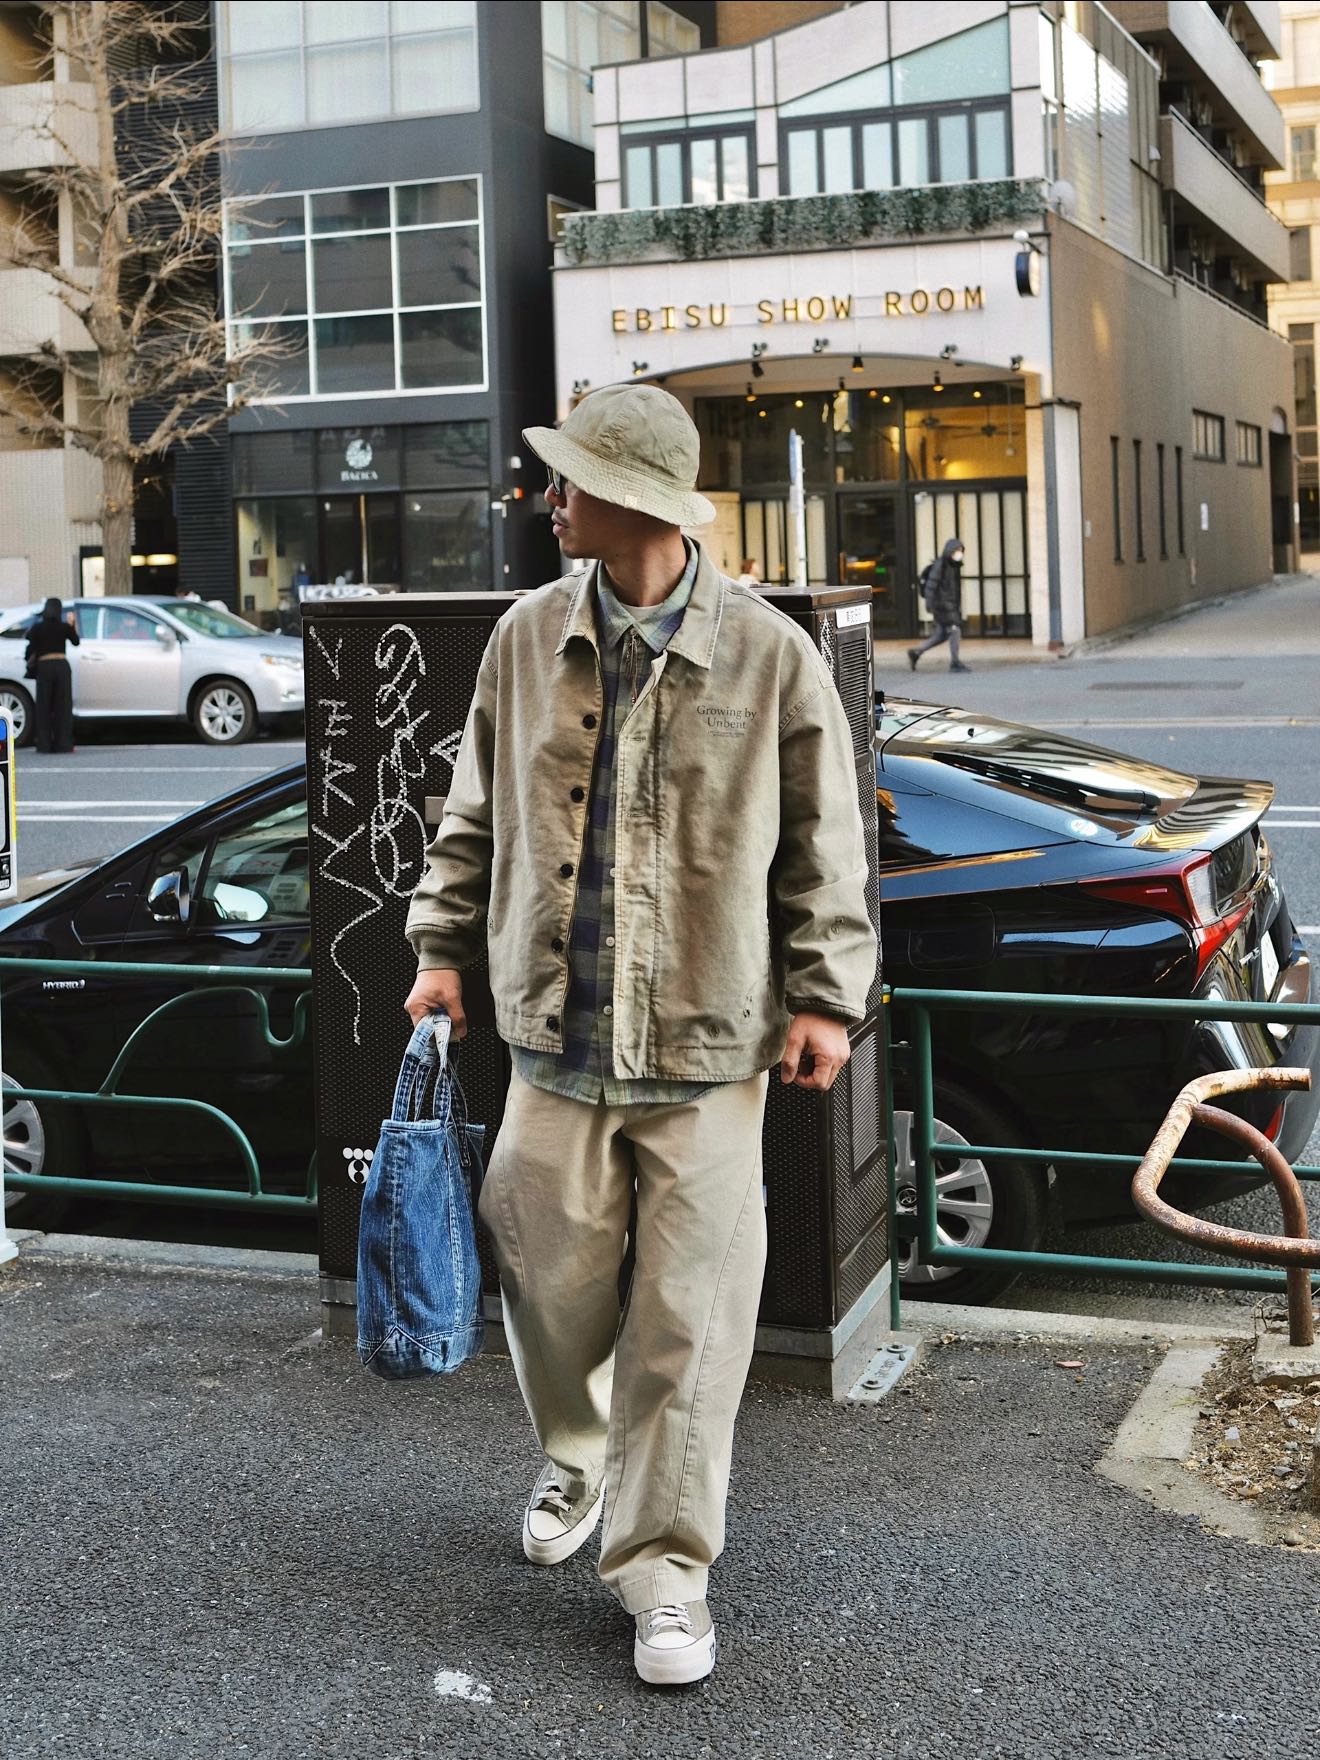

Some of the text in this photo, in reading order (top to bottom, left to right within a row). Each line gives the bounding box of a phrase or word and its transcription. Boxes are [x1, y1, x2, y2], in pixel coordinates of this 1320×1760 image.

[611, 285, 985, 333] EBISU SHOW ROOM
[696, 705, 757, 721] Growing by
[707, 717, 746, 729] Unbent
[42, 981, 79, 989] HYBRID
